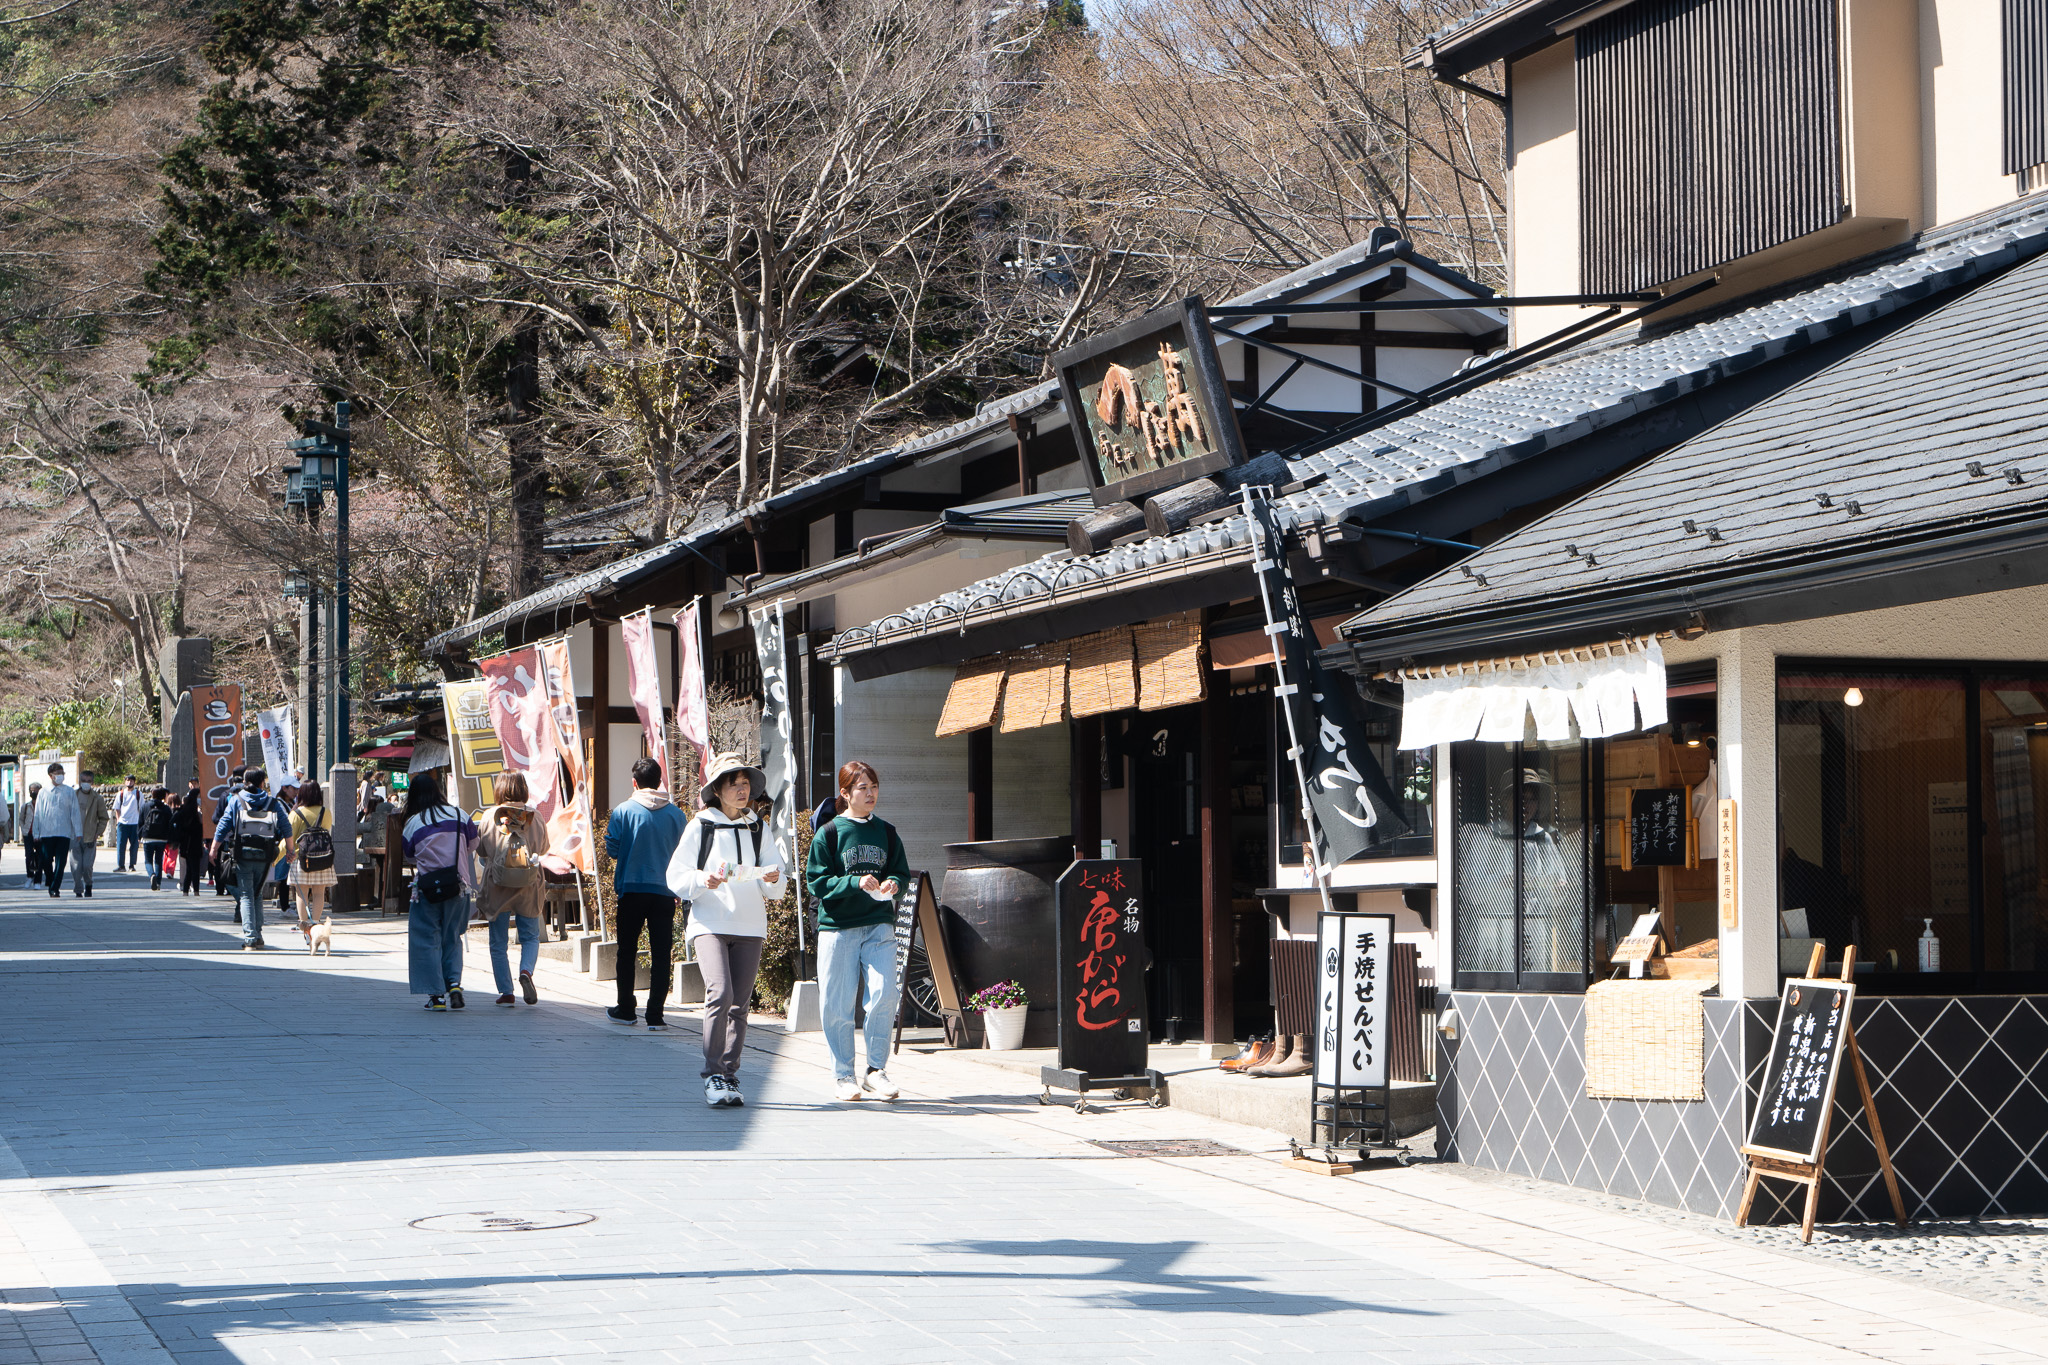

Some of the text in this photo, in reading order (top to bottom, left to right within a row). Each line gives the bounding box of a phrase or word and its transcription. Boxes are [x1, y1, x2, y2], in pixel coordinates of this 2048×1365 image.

[1639, 812, 1650, 854] おります
[1079, 867, 1126, 891] 七味
[1123, 897, 1140, 934] 名物
[1075, 890, 1137, 1031] 唐がらし
[1353, 932, 1376, 1071] 手焼せんべい
